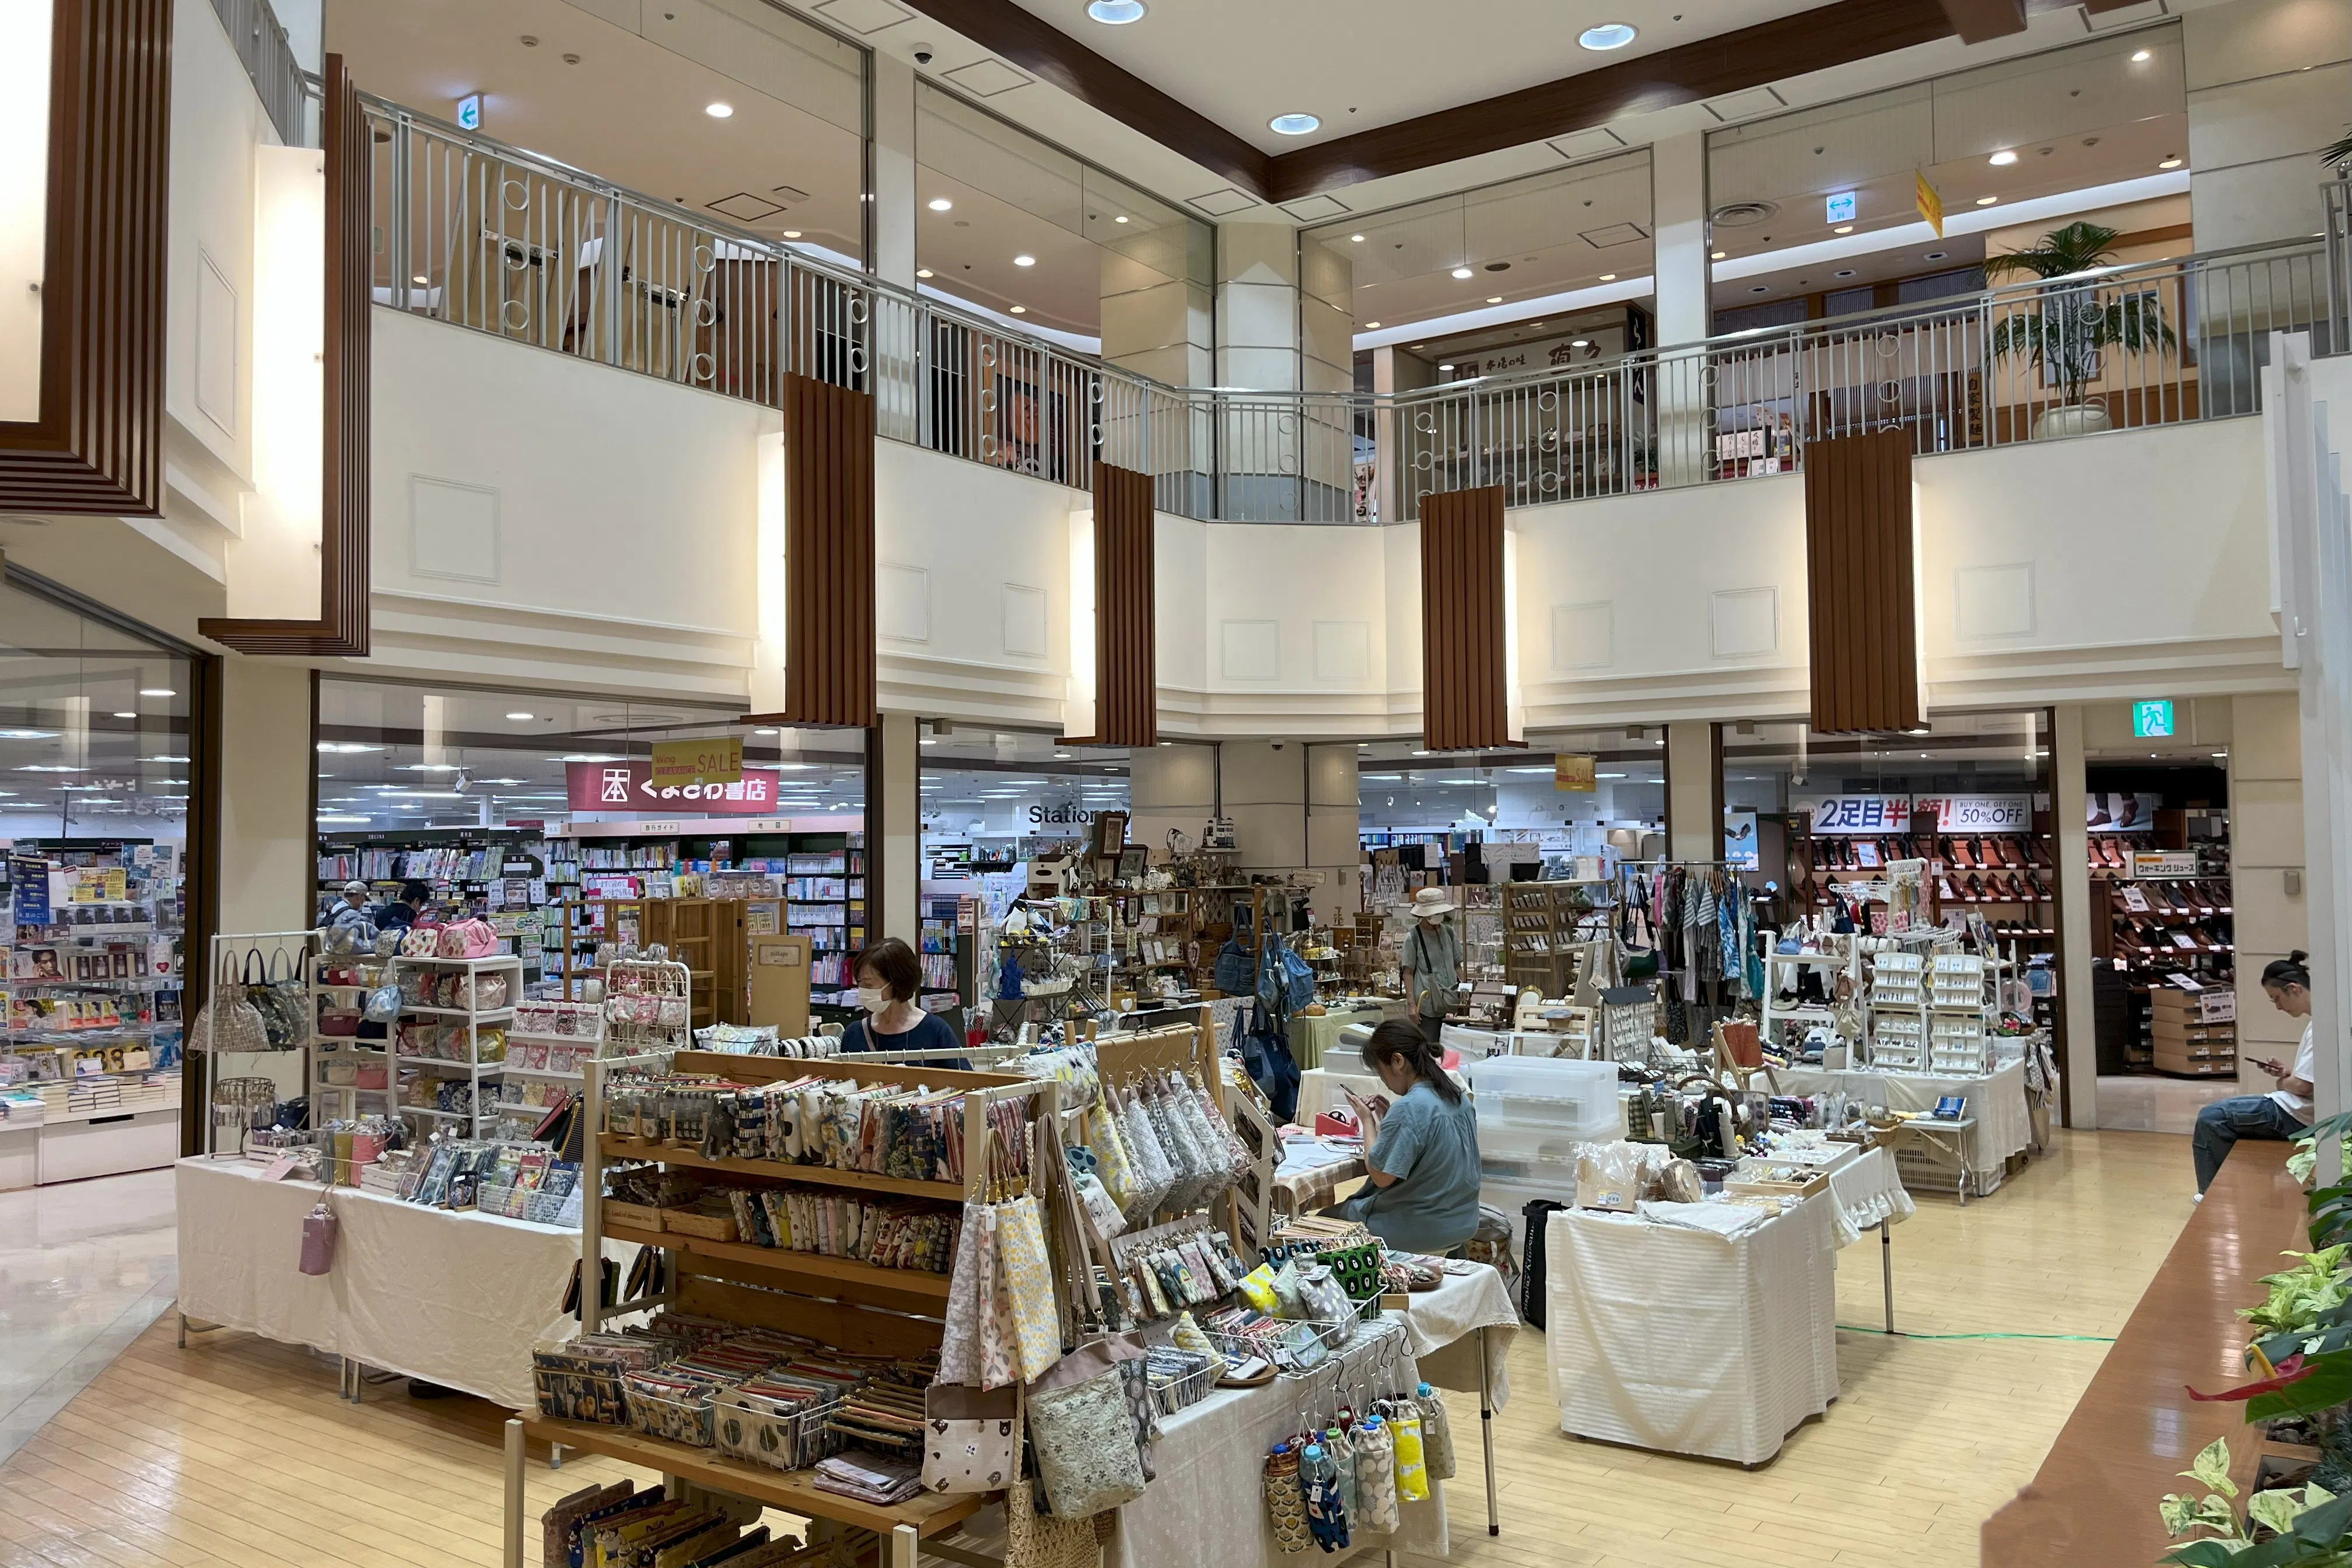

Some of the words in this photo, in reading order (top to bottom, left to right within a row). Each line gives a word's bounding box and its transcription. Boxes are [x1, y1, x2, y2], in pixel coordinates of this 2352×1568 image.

[656, 754, 676, 765] Wing
[698, 752, 739, 774] SALE
[656, 766, 695, 775] CLEARANCE
[1576, 768, 1595, 784] SALE
[1960, 808, 2024, 824] 50%OFF
